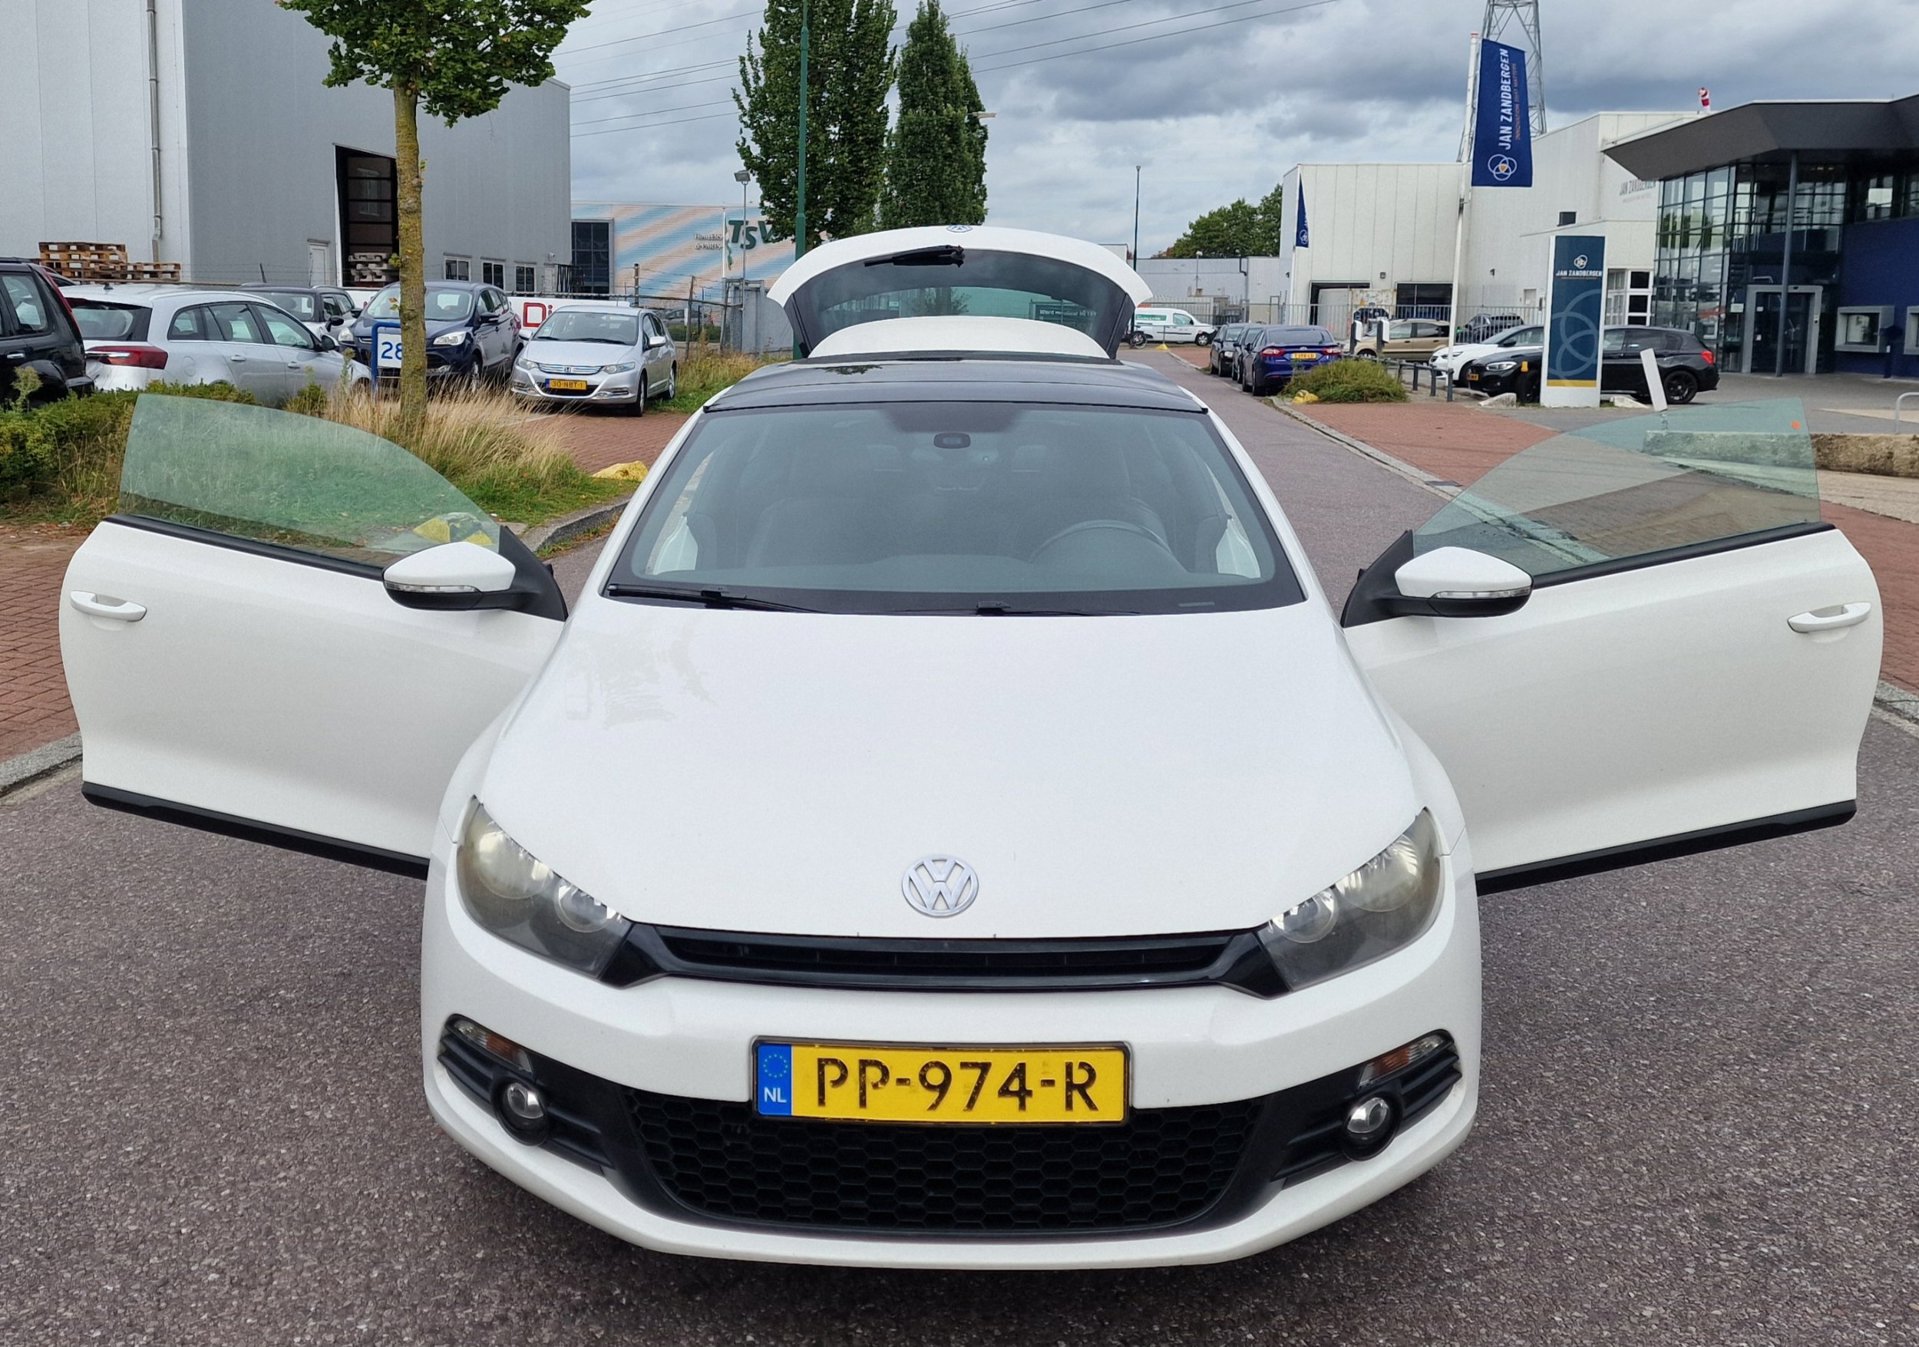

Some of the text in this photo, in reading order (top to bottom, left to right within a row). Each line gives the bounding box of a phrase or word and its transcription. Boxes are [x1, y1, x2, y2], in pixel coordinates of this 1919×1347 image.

[1498, 48, 1513, 150] JAN ZANDBERGEN
[764, 1087, 787, 1104] NL
[816, 1057, 1099, 1112] PP-974-R
